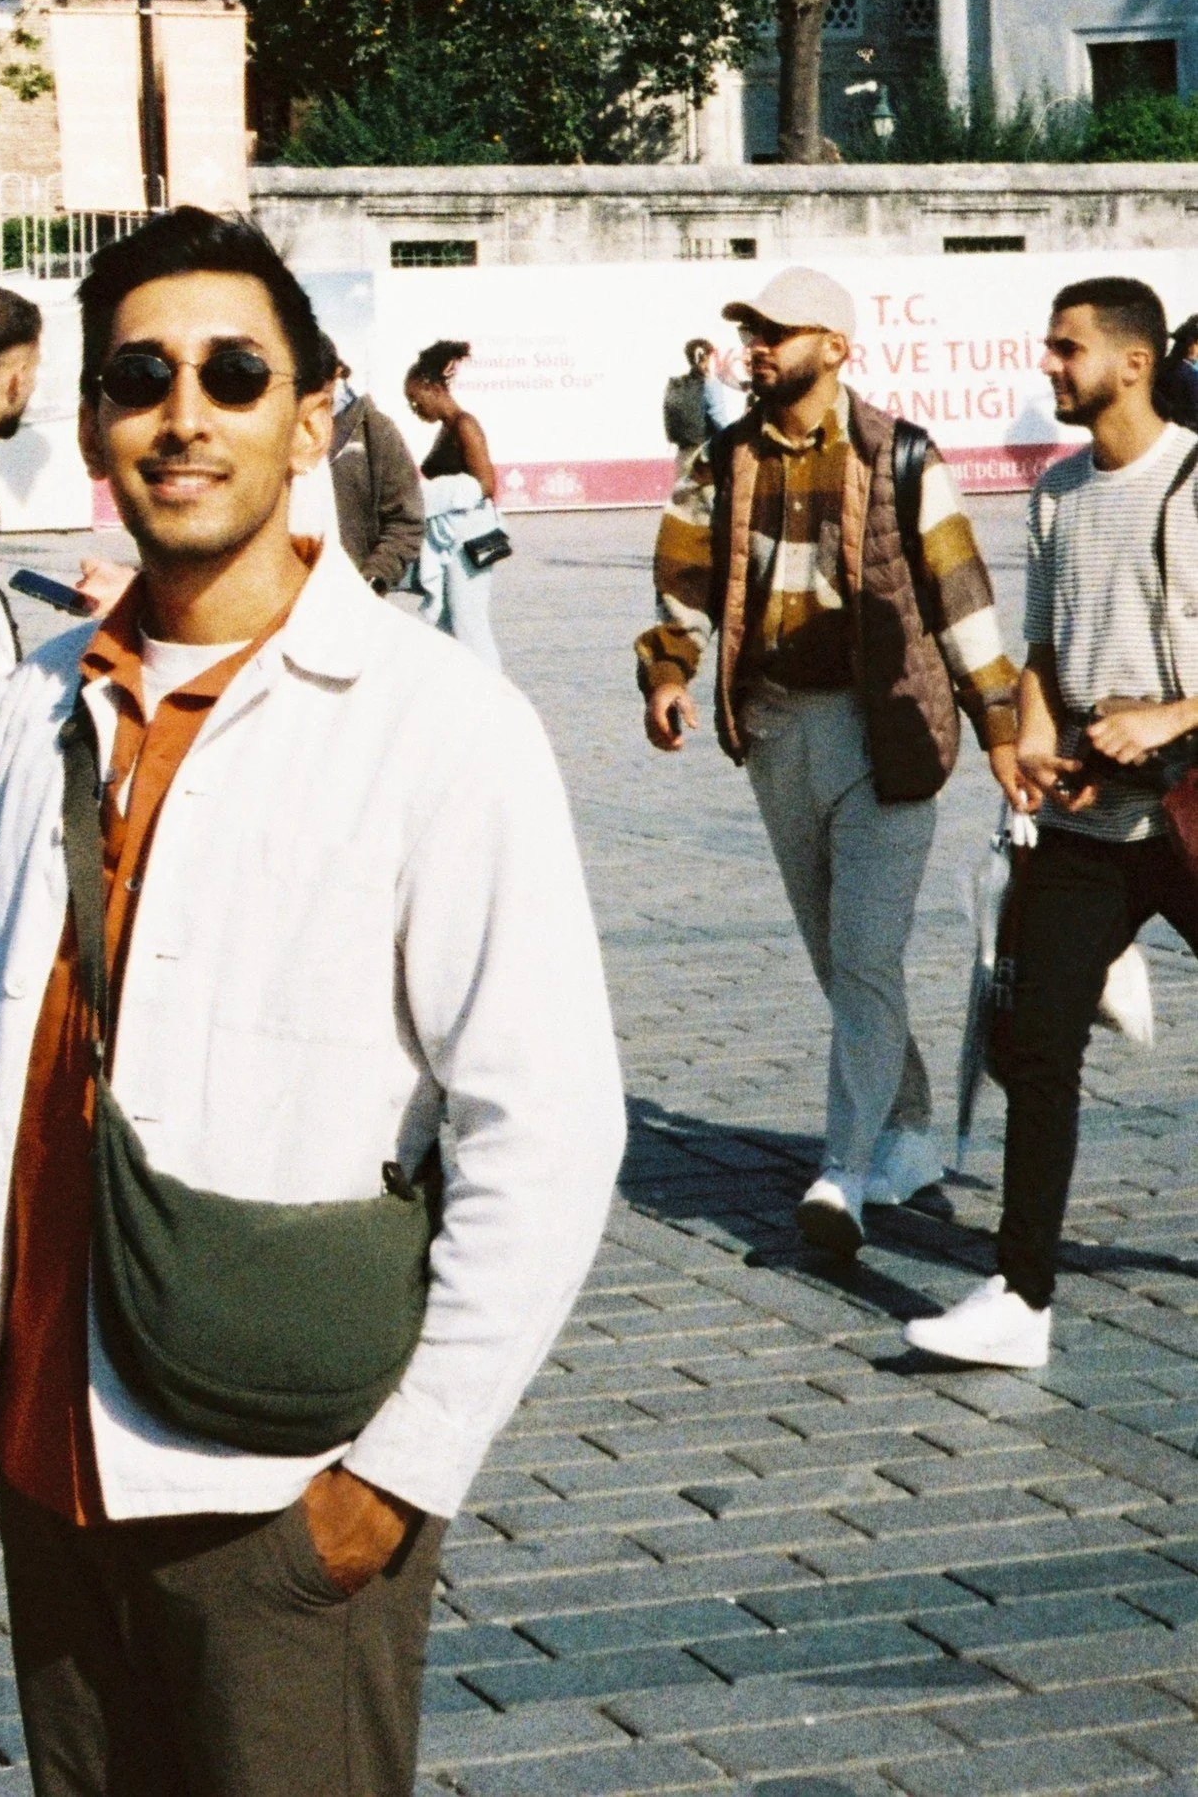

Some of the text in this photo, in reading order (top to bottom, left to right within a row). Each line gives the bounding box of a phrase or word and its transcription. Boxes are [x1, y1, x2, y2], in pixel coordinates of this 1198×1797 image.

[870, 293, 937, 328] T.C.
[881, 341, 929, 376] VE
[944, 330, 1048, 373] TURİ
[862, 380, 1016, 424] ANLIĞI
